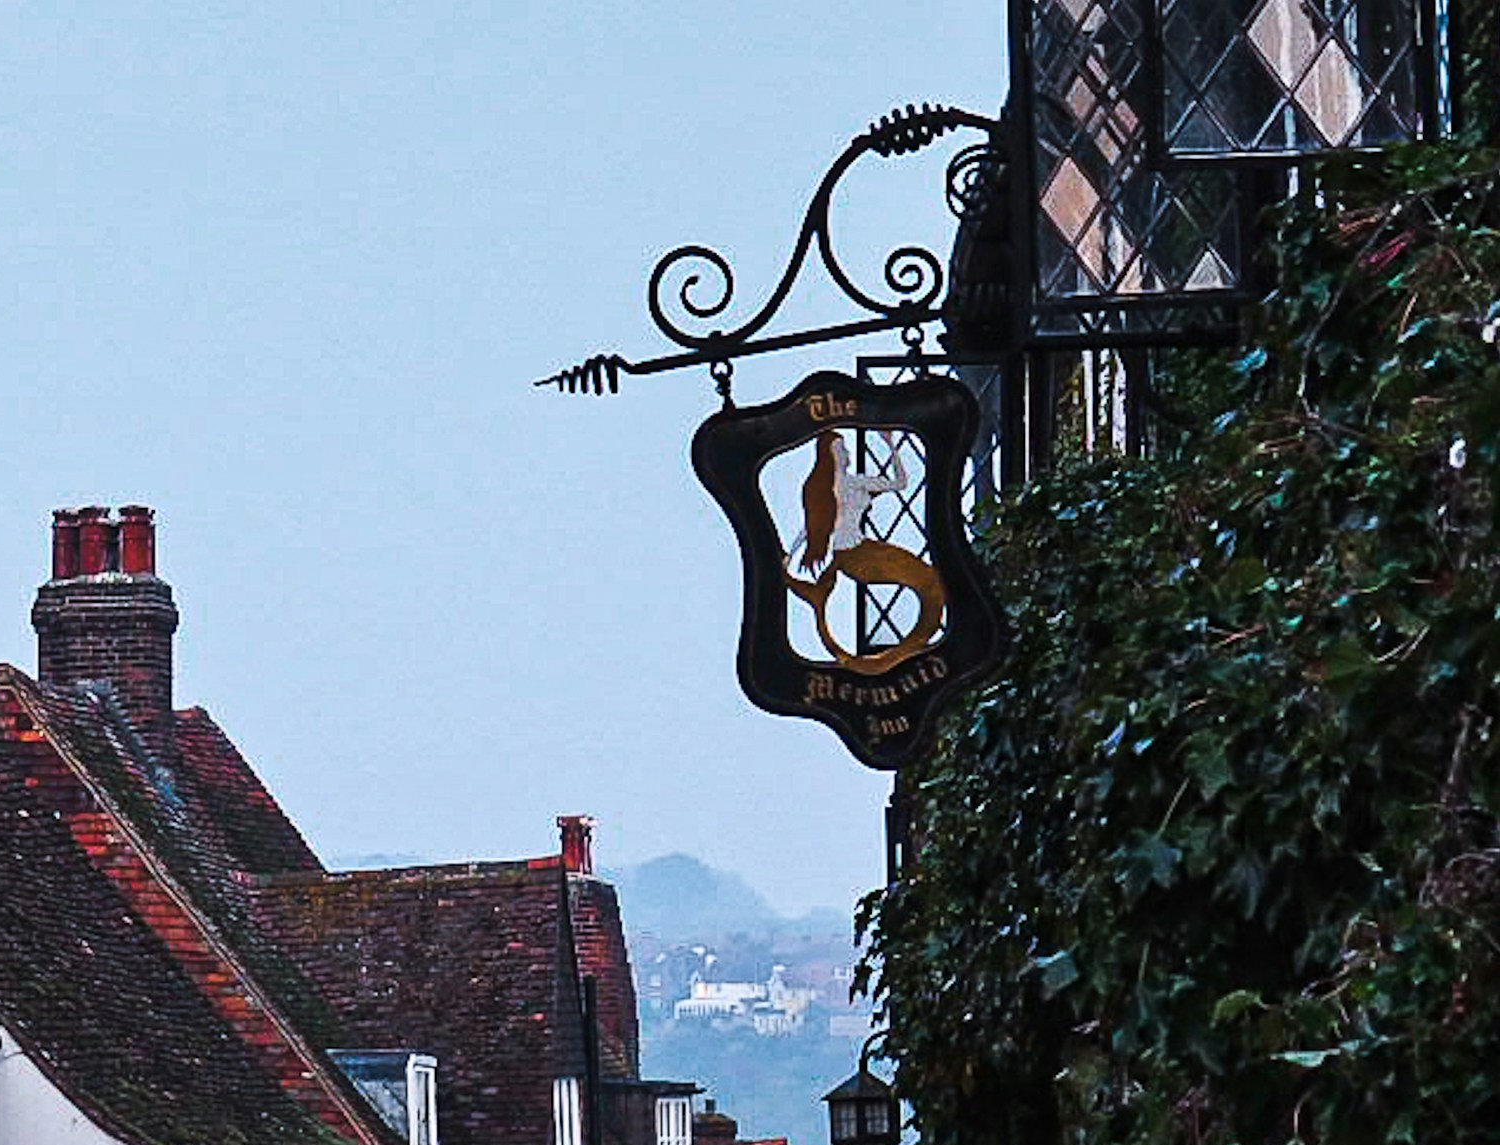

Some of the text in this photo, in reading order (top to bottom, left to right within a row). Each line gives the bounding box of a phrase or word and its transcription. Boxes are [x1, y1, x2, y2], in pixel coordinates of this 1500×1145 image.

[809, 391, 858, 421] The
[804, 655, 948, 706] Mermaid
[867, 714, 910, 746] Inn
